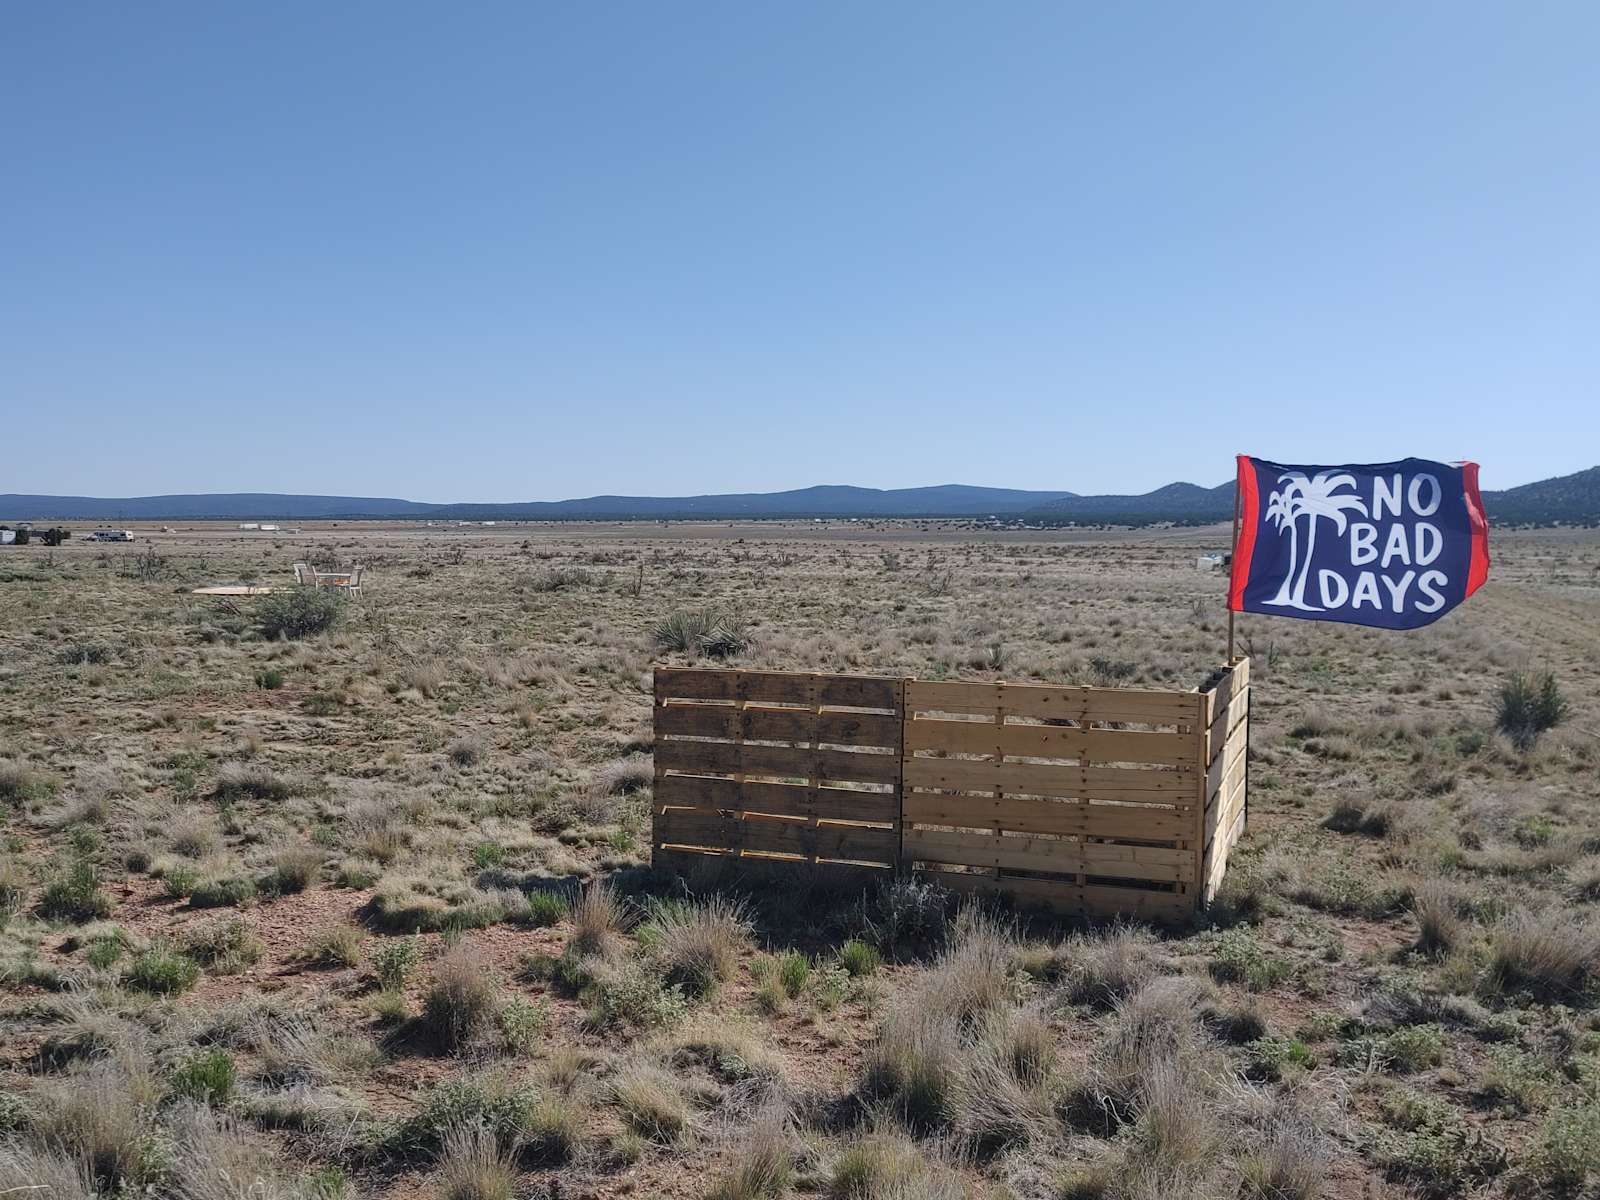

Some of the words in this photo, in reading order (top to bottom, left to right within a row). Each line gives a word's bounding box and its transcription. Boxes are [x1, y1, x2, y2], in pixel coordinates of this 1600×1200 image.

[1372, 472, 1442, 521] NO
[1350, 521, 1444, 569] BAD
[1318, 569, 1449, 614] DAYS
